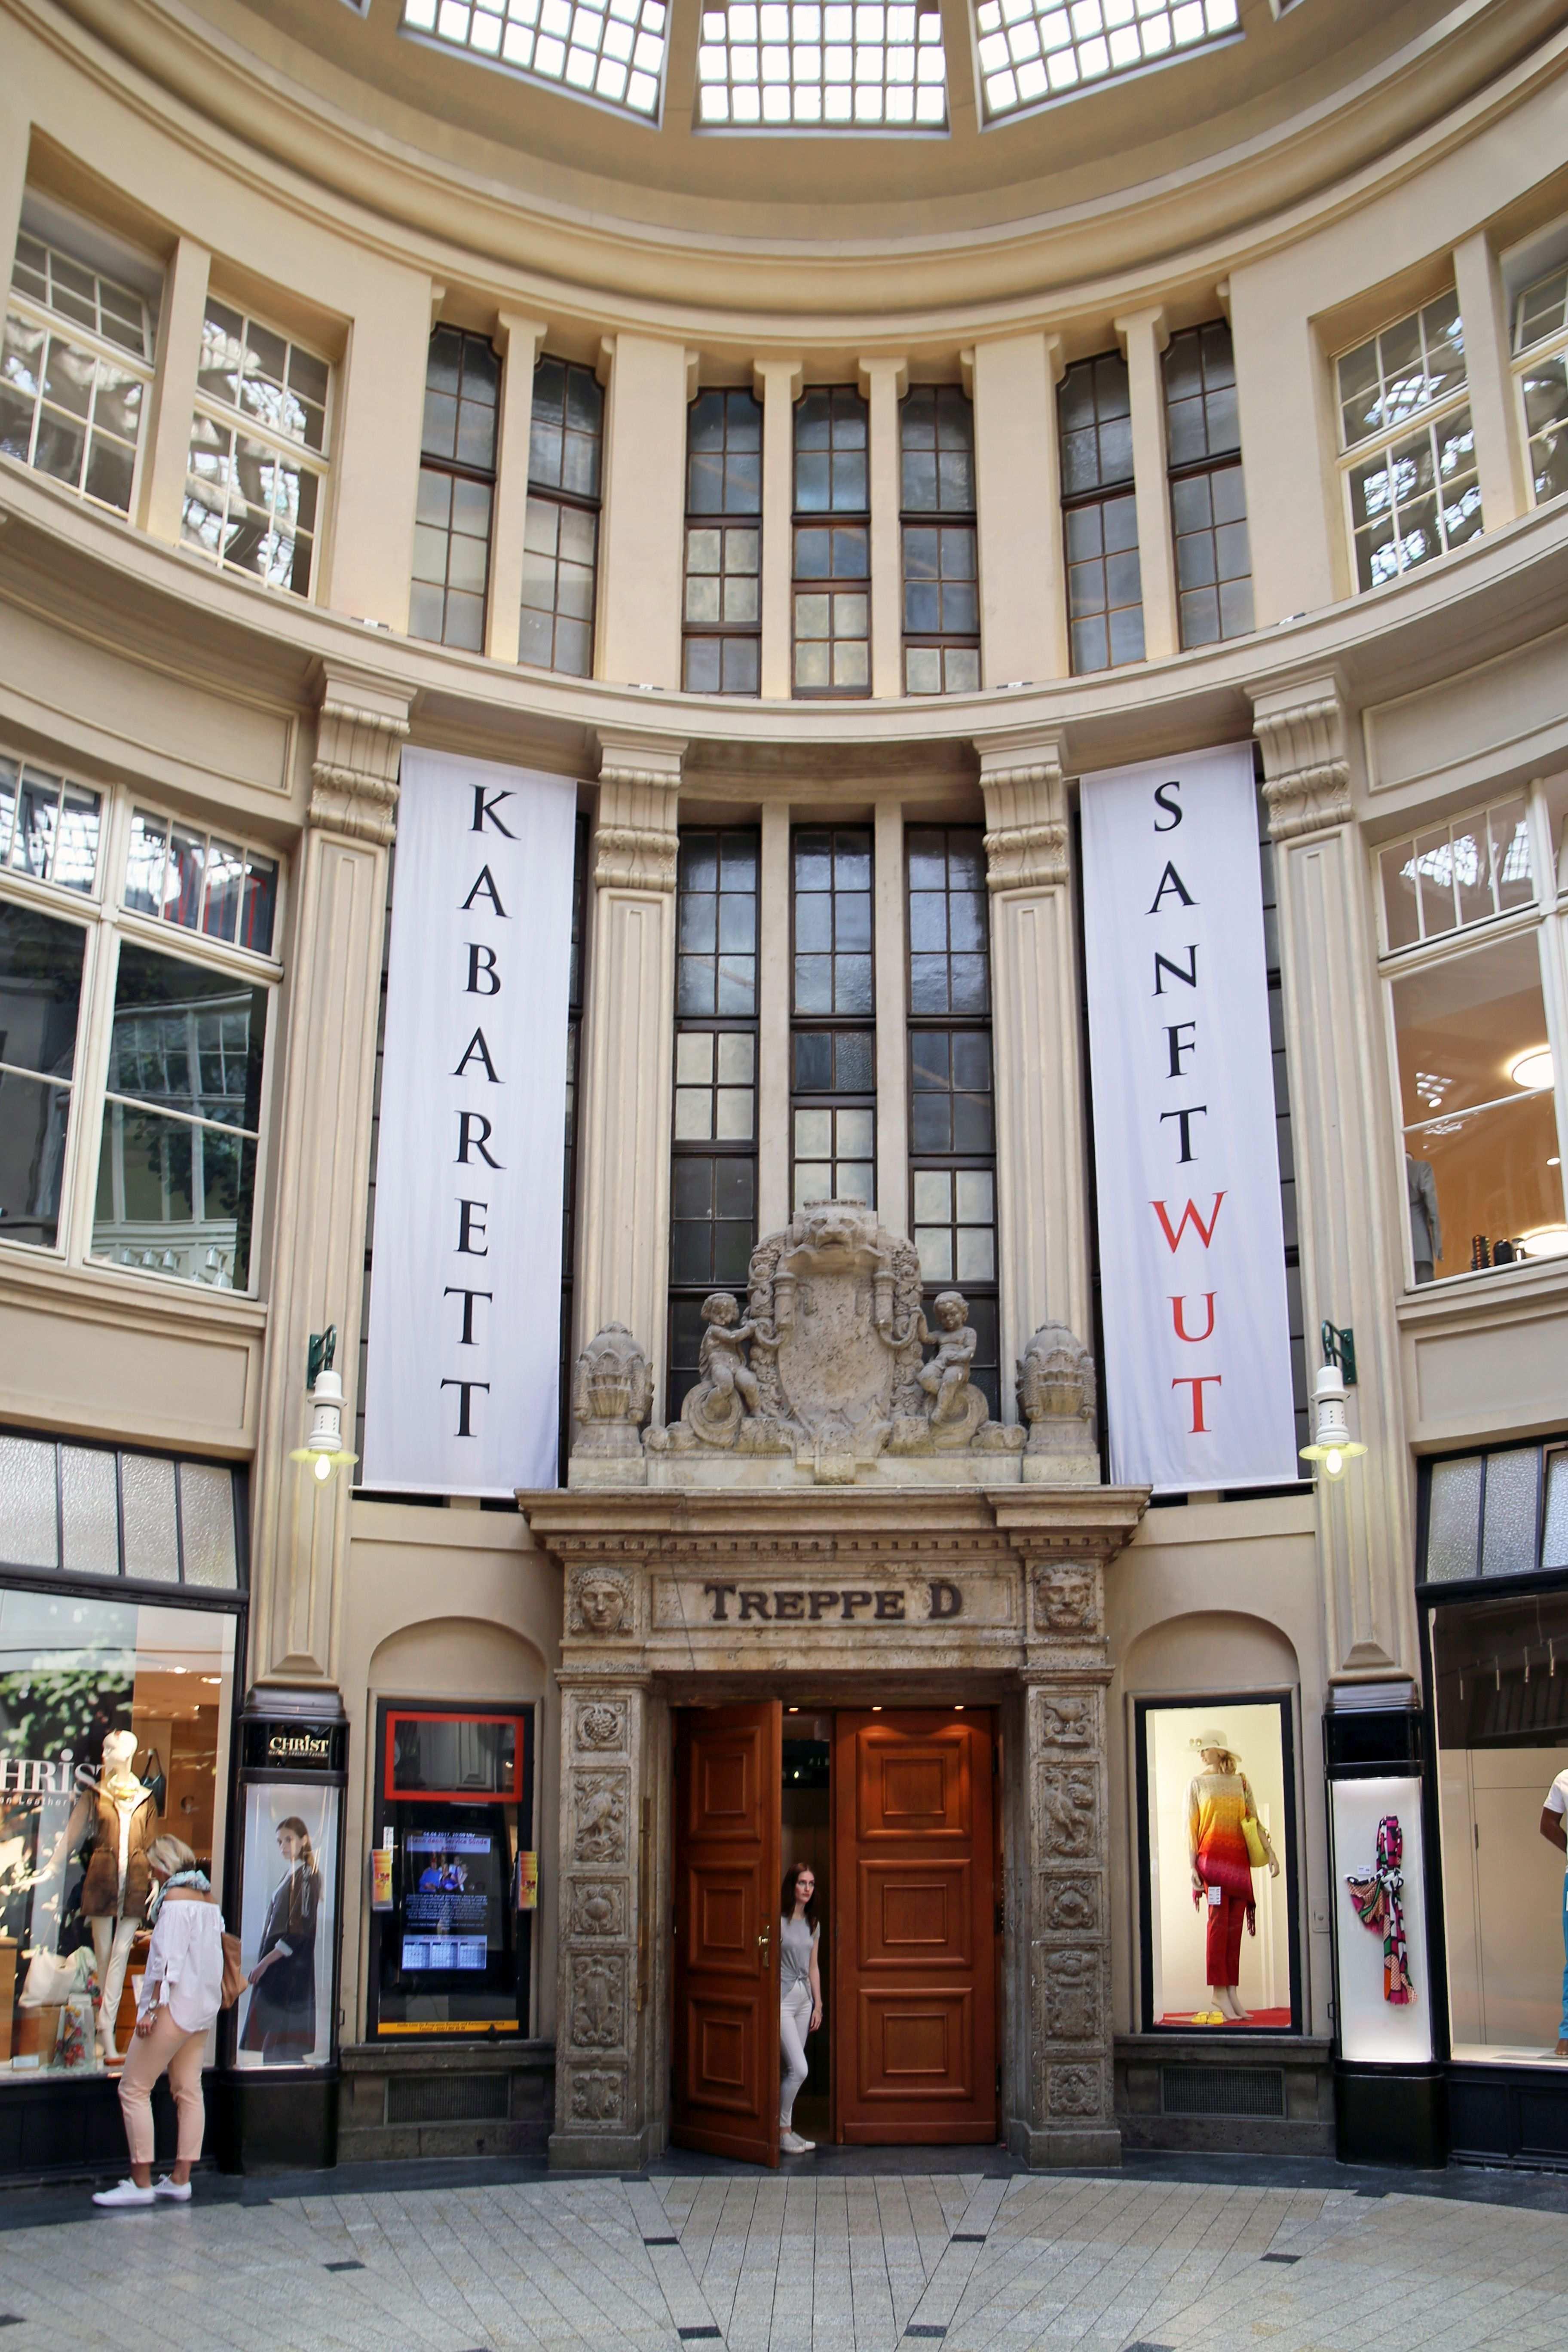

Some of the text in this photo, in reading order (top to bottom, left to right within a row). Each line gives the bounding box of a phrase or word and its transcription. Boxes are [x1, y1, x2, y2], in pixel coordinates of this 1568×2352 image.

[440, 784, 520, 1437] KABARETT
[705, 1582, 963, 1619] TREPPE D
[19, 1796, 68, 1806] Leather
